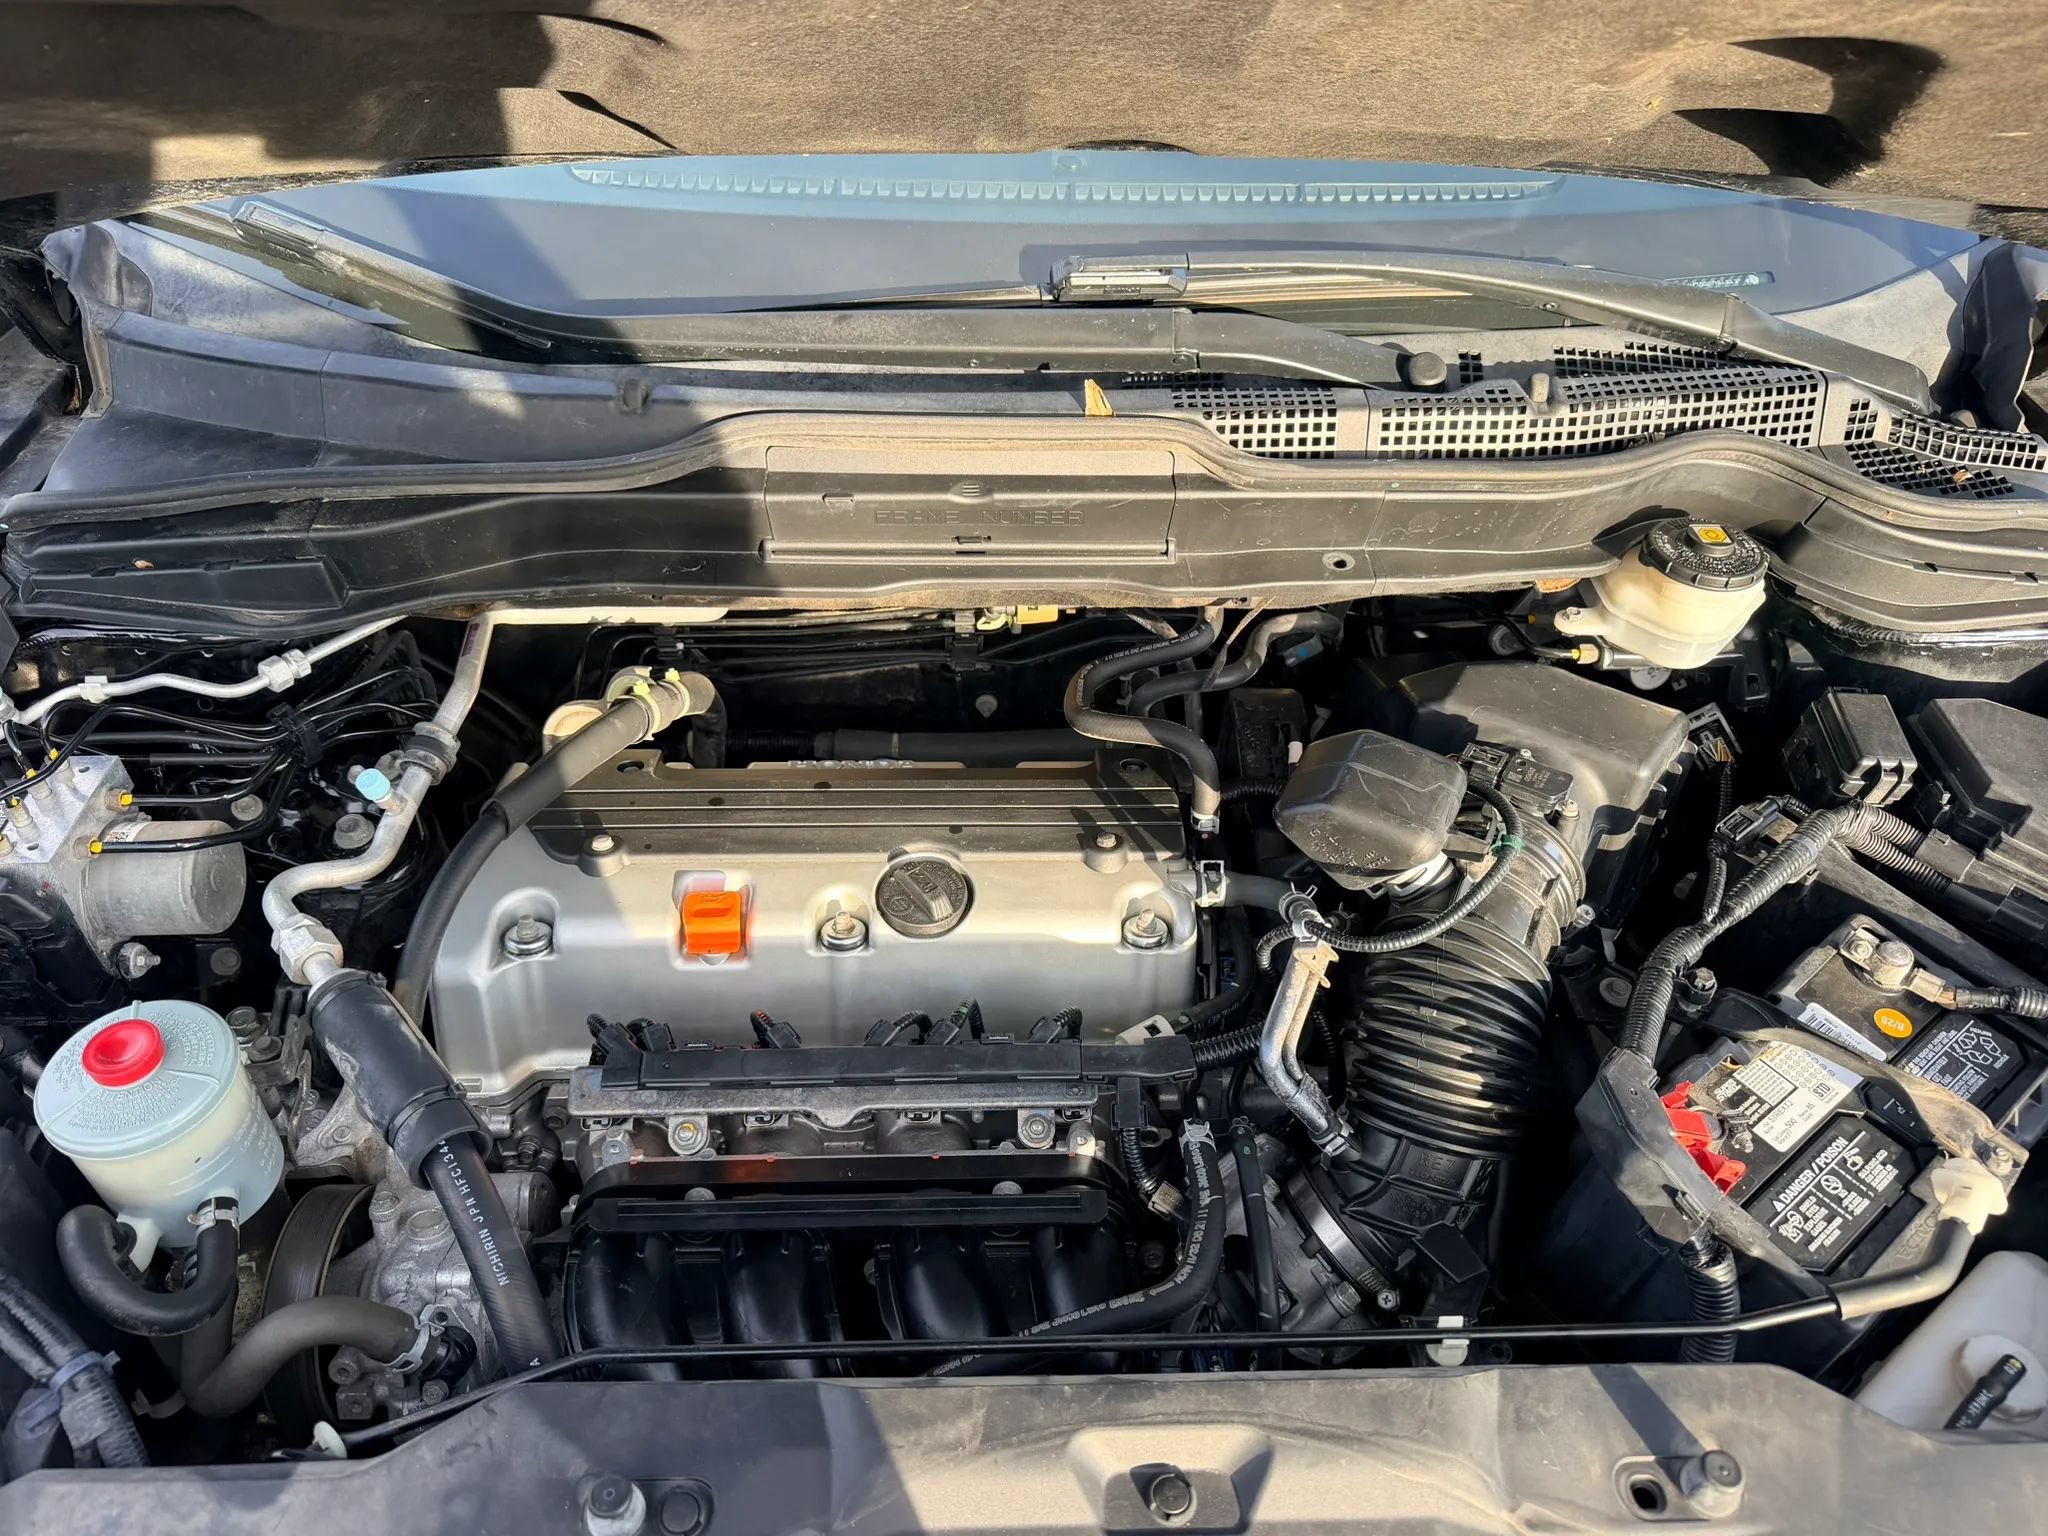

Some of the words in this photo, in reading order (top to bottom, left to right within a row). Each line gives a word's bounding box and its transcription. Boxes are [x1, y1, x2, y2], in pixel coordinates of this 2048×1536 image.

[874, 509, 961, 525] FRAME
[980, 510, 1086, 526] NUMBER
[1714, 1078, 1736, 1096] SUPER
[1813, 1081, 1831, 1098] STD
[1785, 1117, 1798, 1129] 500
[1875, 1148, 1888, 1161] ACID
[464, 1196, 484, 1223] JPN
[1798, 1195, 1817, 1212] SHIELD
[1805, 1203, 1819, 1217] EYES
[1803, 1207, 1828, 1231] EXPLOSIVE
[478, 1228, 510, 1286] NICHIRIN
